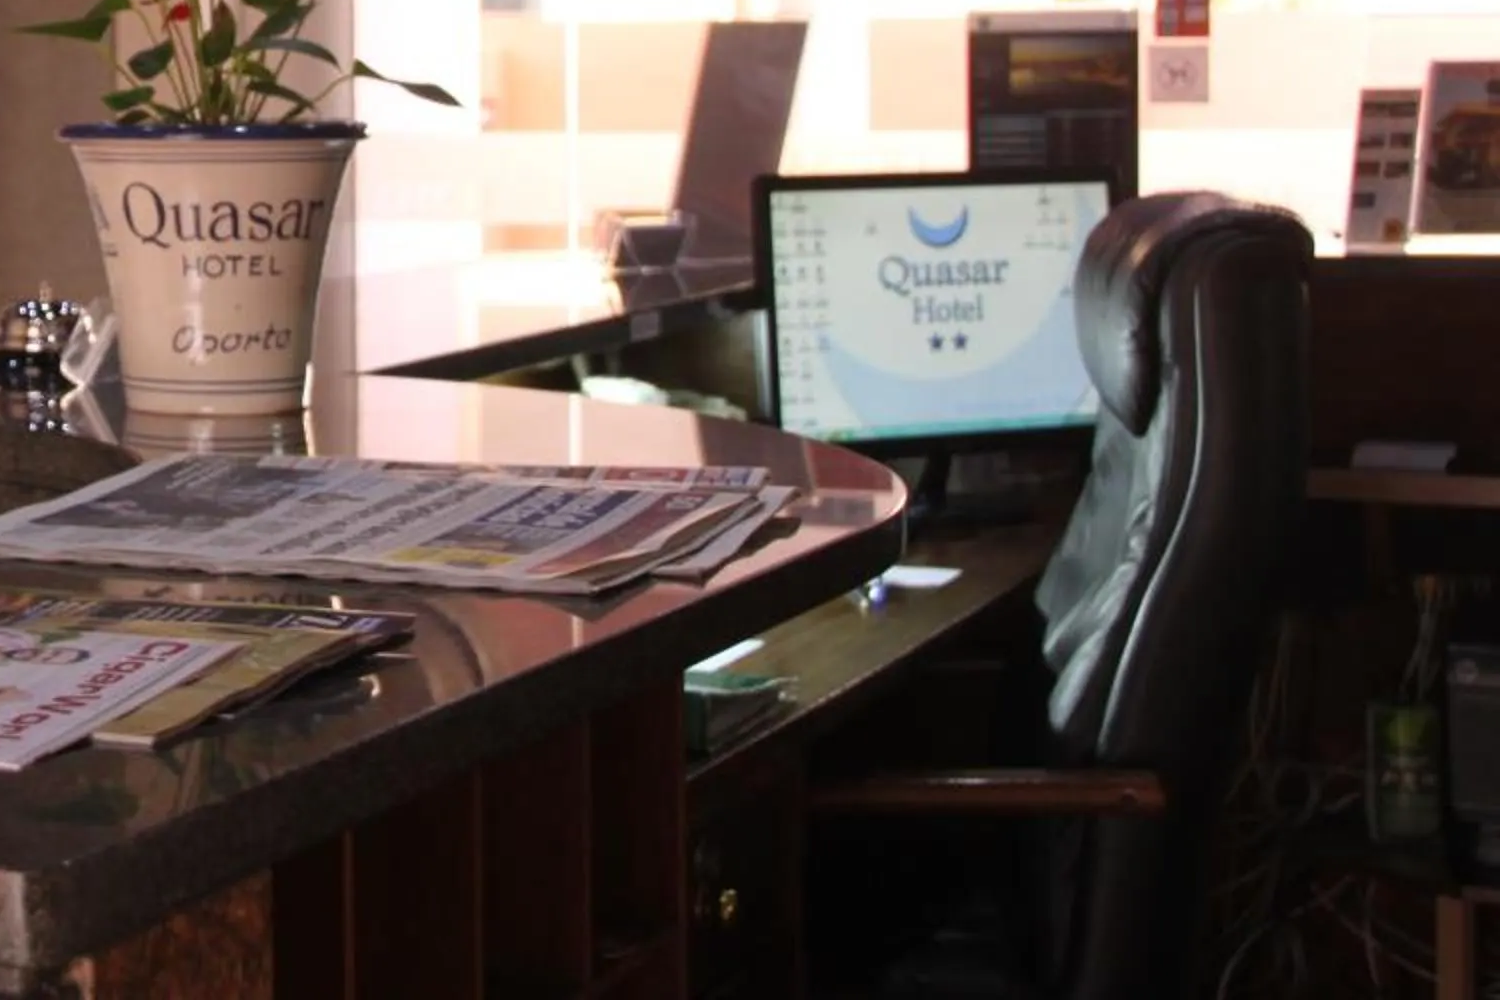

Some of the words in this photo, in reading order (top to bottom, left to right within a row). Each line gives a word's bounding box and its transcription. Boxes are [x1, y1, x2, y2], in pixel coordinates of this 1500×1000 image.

[122, 181, 324, 248] Quasar
[182, 254, 283, 278] HOTEL
[878, 255, 1009, 296] Quasar
[912, 294, 984, 325] Hotel
